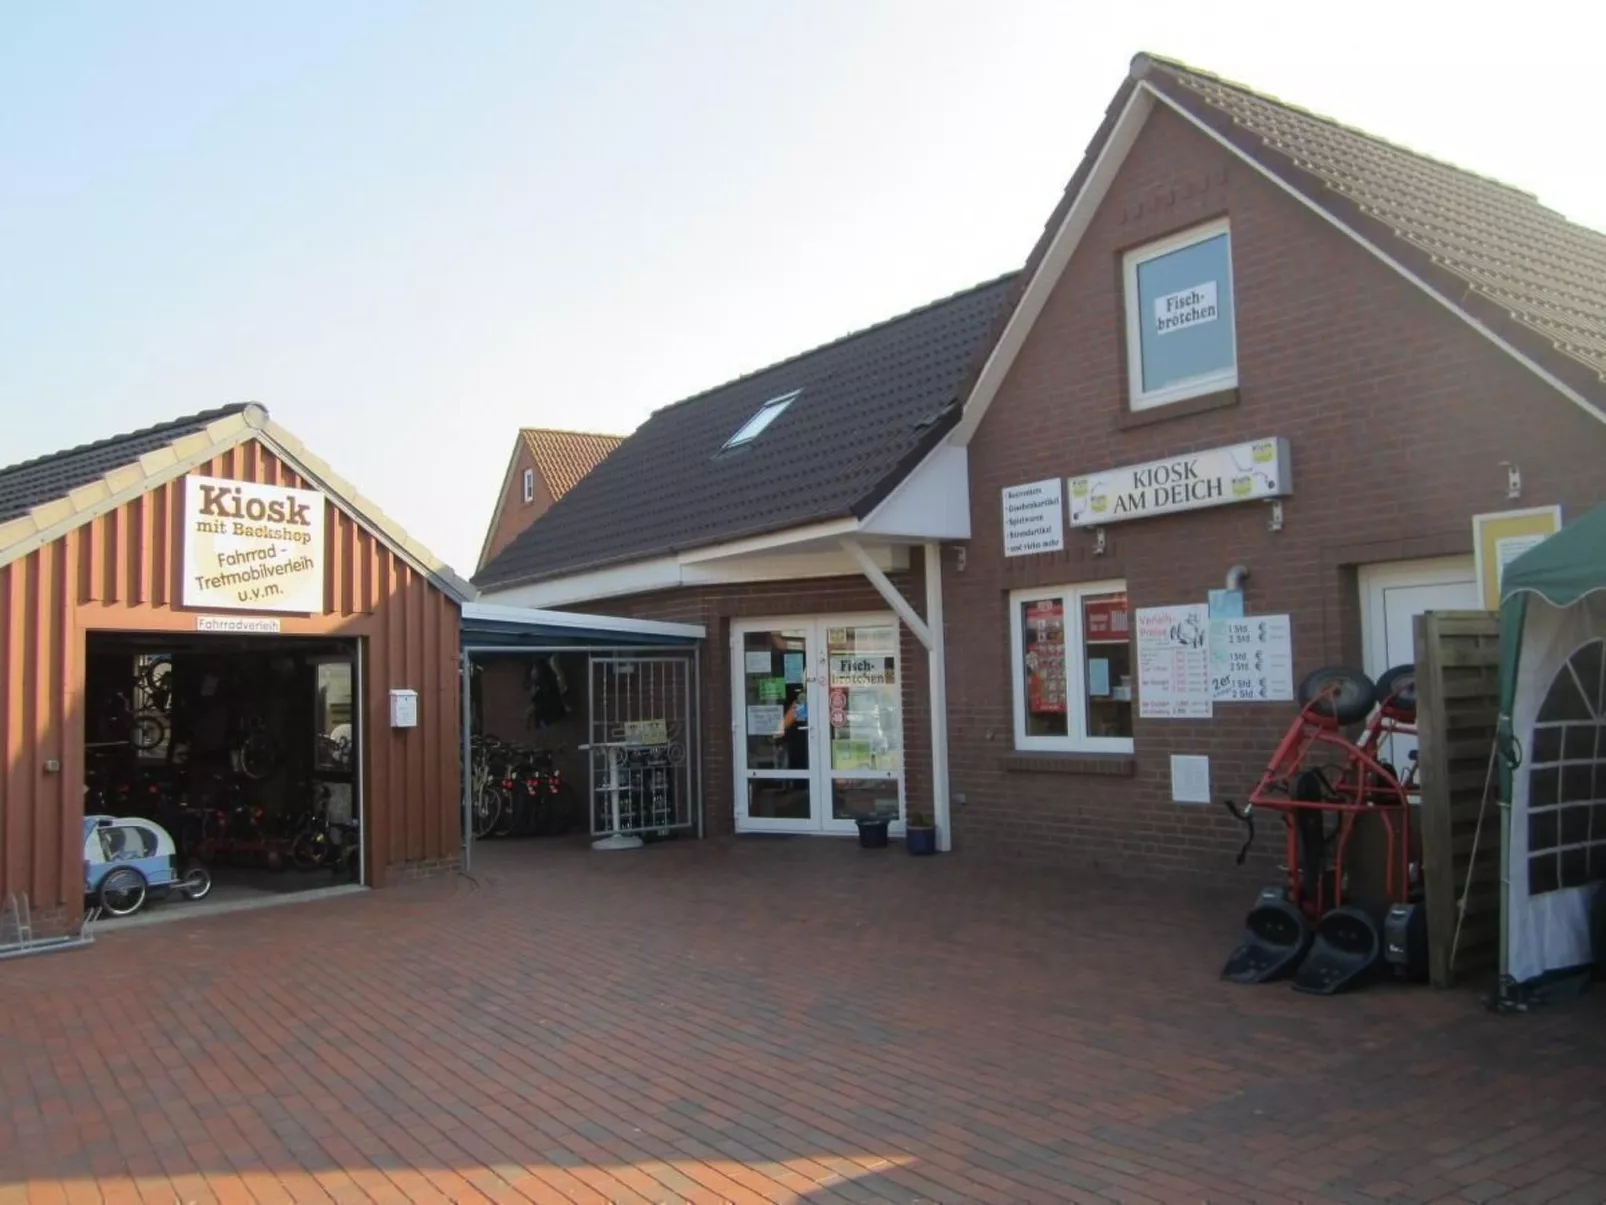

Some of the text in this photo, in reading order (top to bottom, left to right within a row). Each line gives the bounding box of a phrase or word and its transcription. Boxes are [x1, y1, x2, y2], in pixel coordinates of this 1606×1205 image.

[1166, 291, 1204, 313] Fisch-
[1132, 459, 1199, 489] KIOSK
[199, 484, 311, 526] Kiosk
[1114, 477, 1223, 514] AM DEICH
[196, 519, 312, 545] mit Backshop
[217, 543, 277, 568] Fahrrad
[195, 556, 314, 591] Tretmobilverleih
[238, 583, 284, 602] u.v.m.
[199, 619, 278, 632] Fahrradverleih
